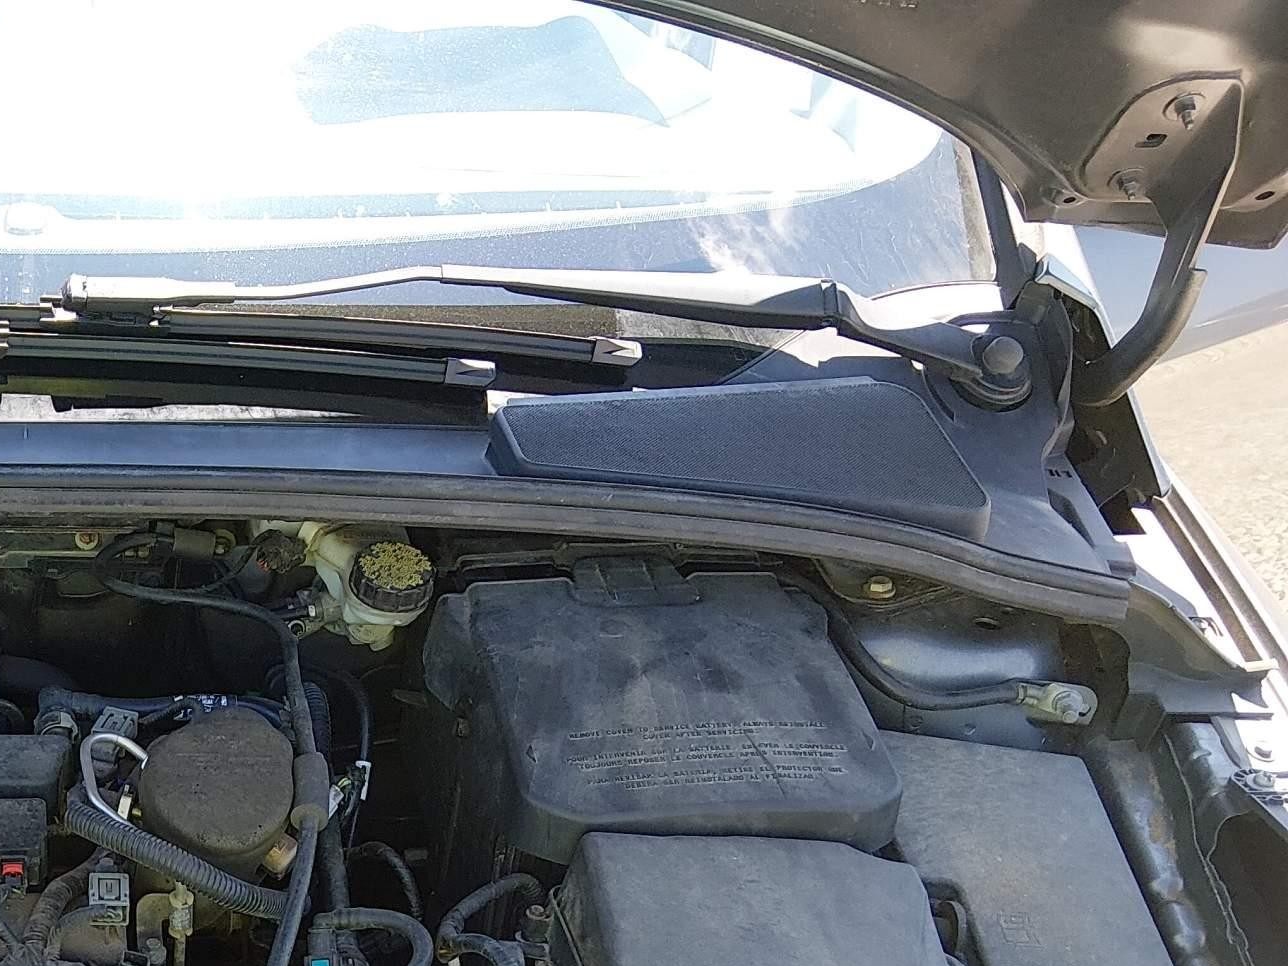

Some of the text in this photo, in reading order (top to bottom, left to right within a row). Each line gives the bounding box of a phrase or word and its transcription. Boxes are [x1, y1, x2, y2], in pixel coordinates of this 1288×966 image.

[569, 730, 600, 739] REMOVE
[606, 728, 633, 736] COVER
[654, 723, 689, 732] SERVICE
